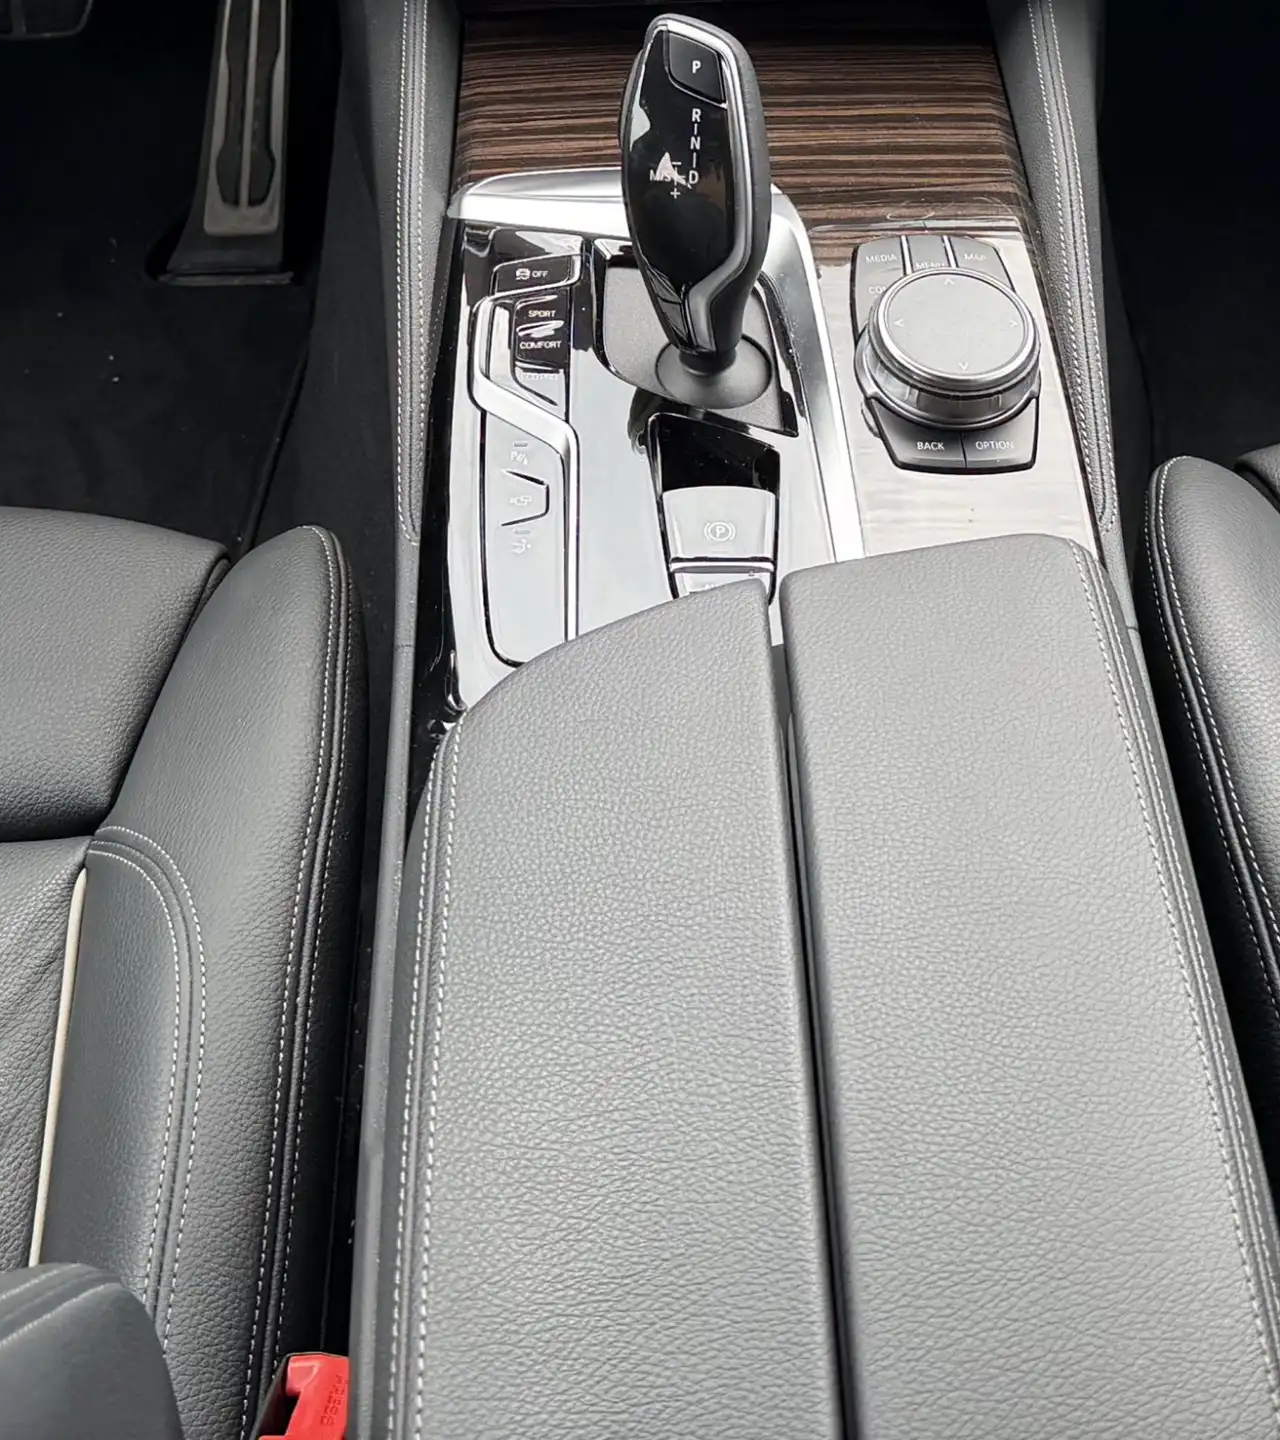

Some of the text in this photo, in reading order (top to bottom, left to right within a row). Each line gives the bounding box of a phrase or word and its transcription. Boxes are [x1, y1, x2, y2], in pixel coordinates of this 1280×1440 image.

[692, 61, 702, 73] P
[692, 108, 701, 122] R
[690, 136, 701, 150] N
[688, 171, 699, 184] D
[865, 253, 897, 263] MEDIA
[532, 270, 549, 278] OFF
[528, 309, 557, 318] SPORT
[519, 340, 562, 350] COMFORT
[916, 441, 945, 450] BACK
[975, 440, 1015, 450] OPTION
